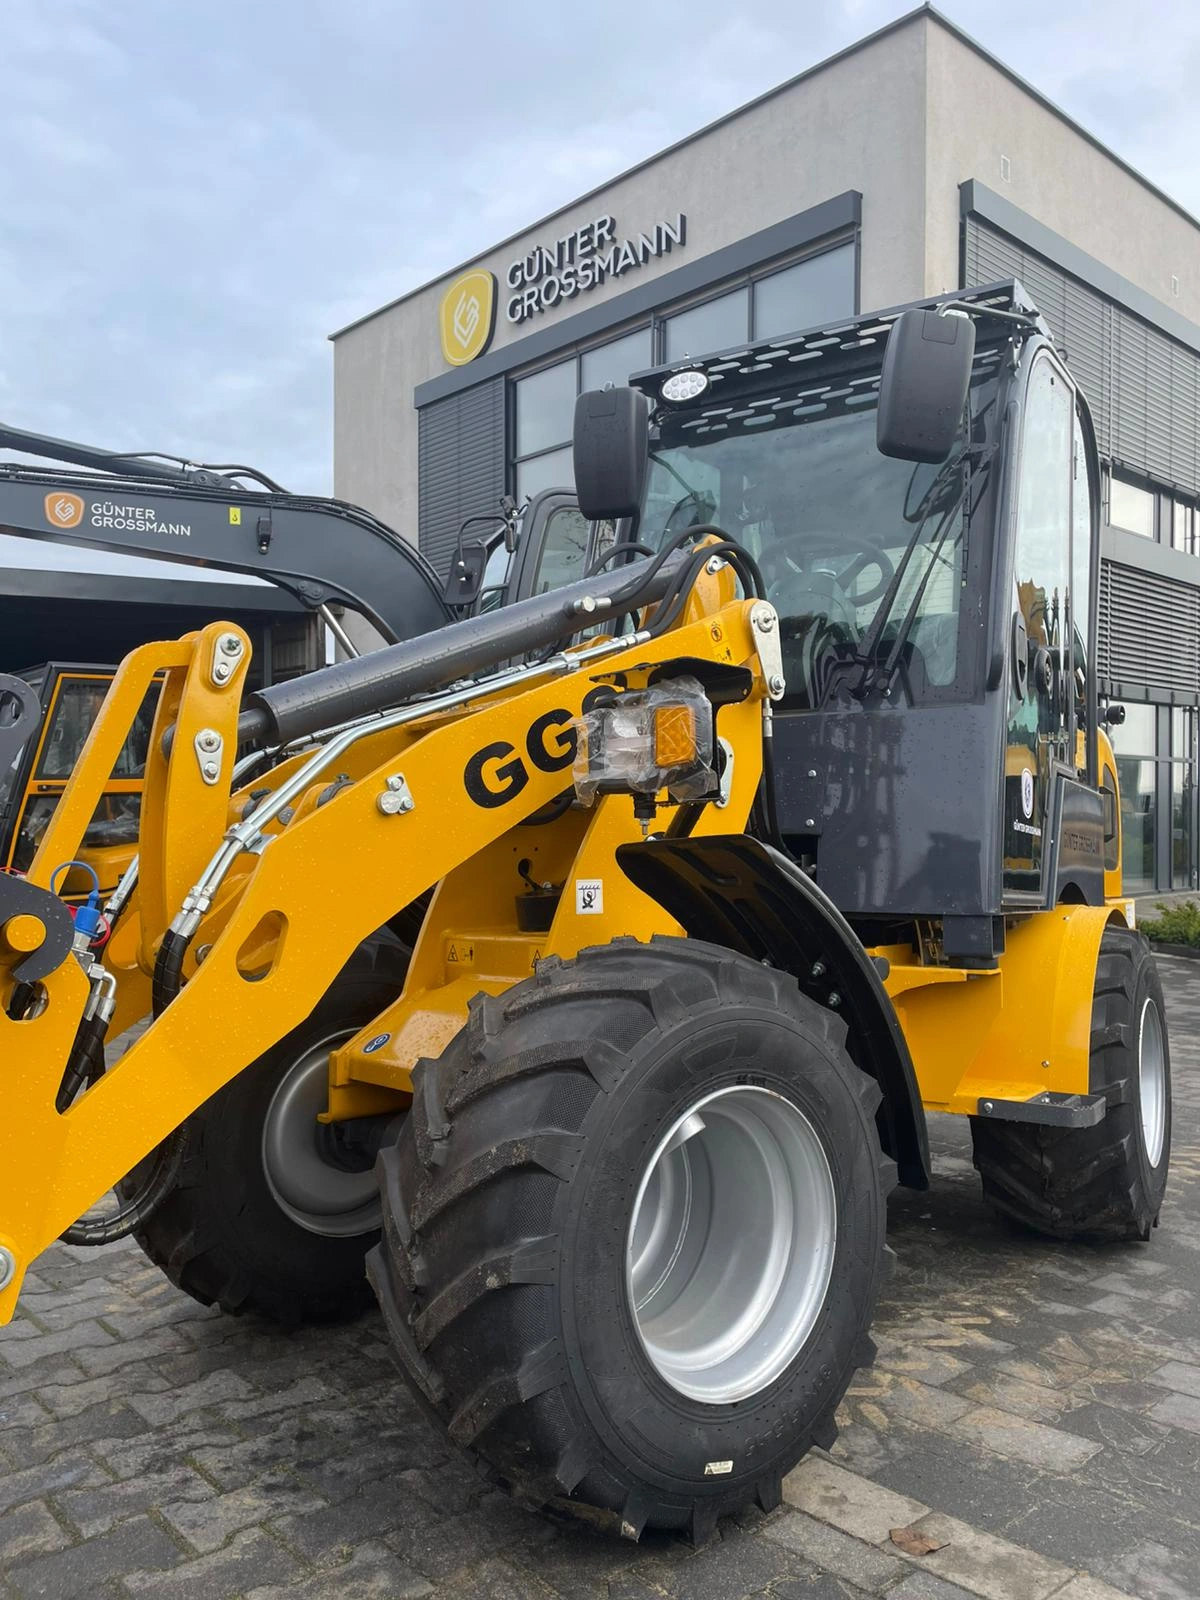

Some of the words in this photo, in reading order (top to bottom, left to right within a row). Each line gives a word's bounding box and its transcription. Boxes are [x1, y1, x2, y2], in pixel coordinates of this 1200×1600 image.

[507, 214, 616, 289] GÜNTER
[507, 212, 687, 324] GROSSMANN
[91, 502, 155, 520] GÜNTER
[91, 515, 191, 536] GROSSMANN
